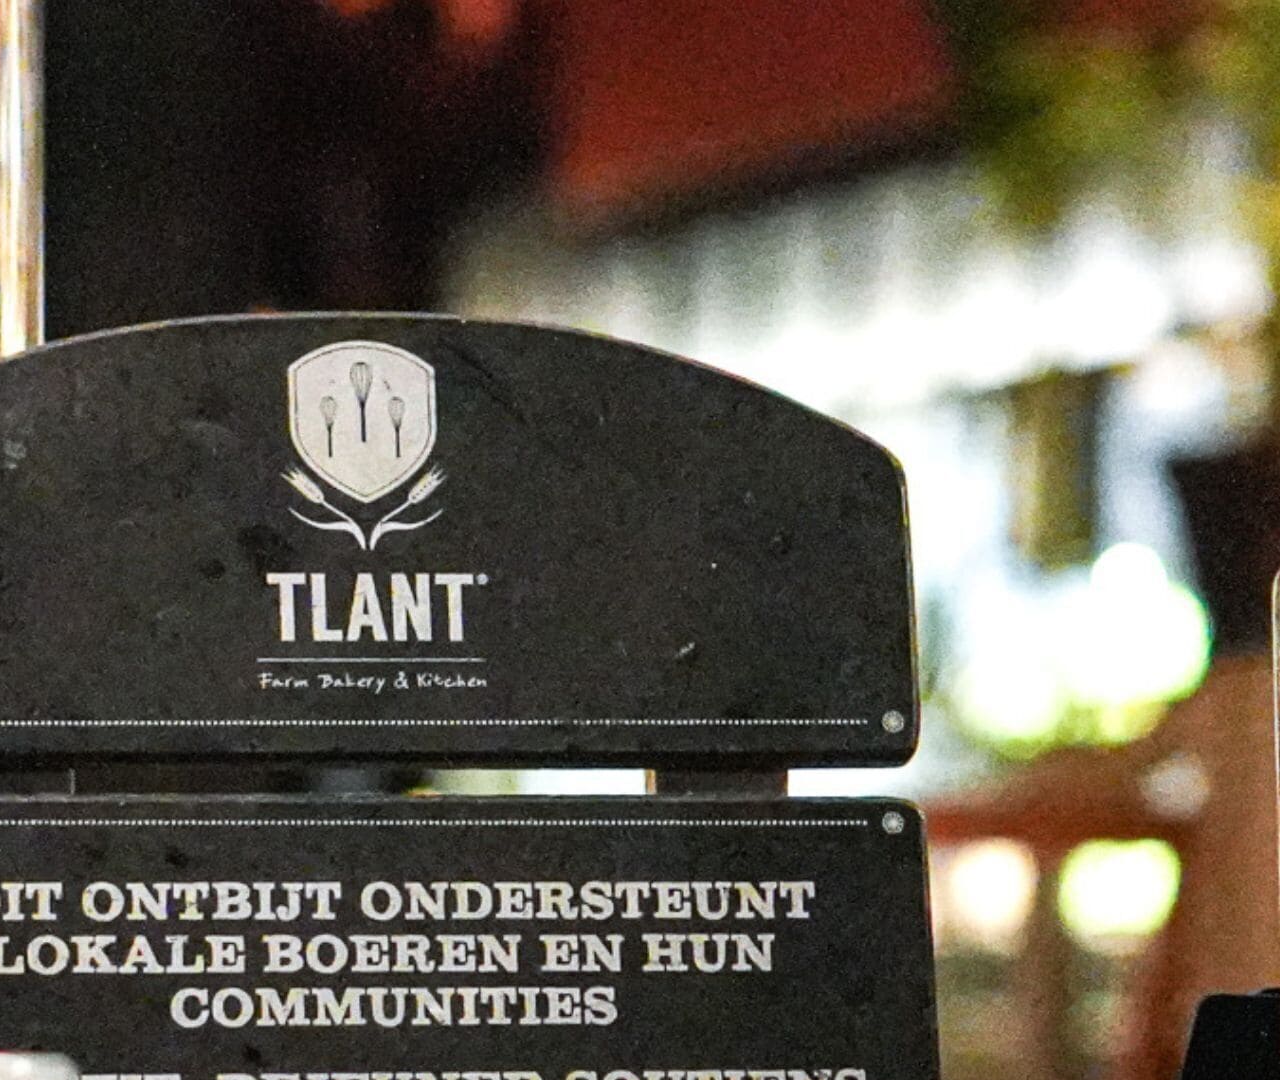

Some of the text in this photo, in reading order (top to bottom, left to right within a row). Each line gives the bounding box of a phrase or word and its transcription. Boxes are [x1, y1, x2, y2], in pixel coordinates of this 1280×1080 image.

[257, 671, 488, 694] Farm Bakery & Kitchen
[81, 881, 342, 922] ONTBIJT
[360, 880, 816, 922] ONDERSTEUNT
[262, 933, 522, 974] BOEREN
[538, 933, 625, 973] EN
[641, 933, 776, 973] HUN
[170, 986, 618, 1028] COMMUNITIES
